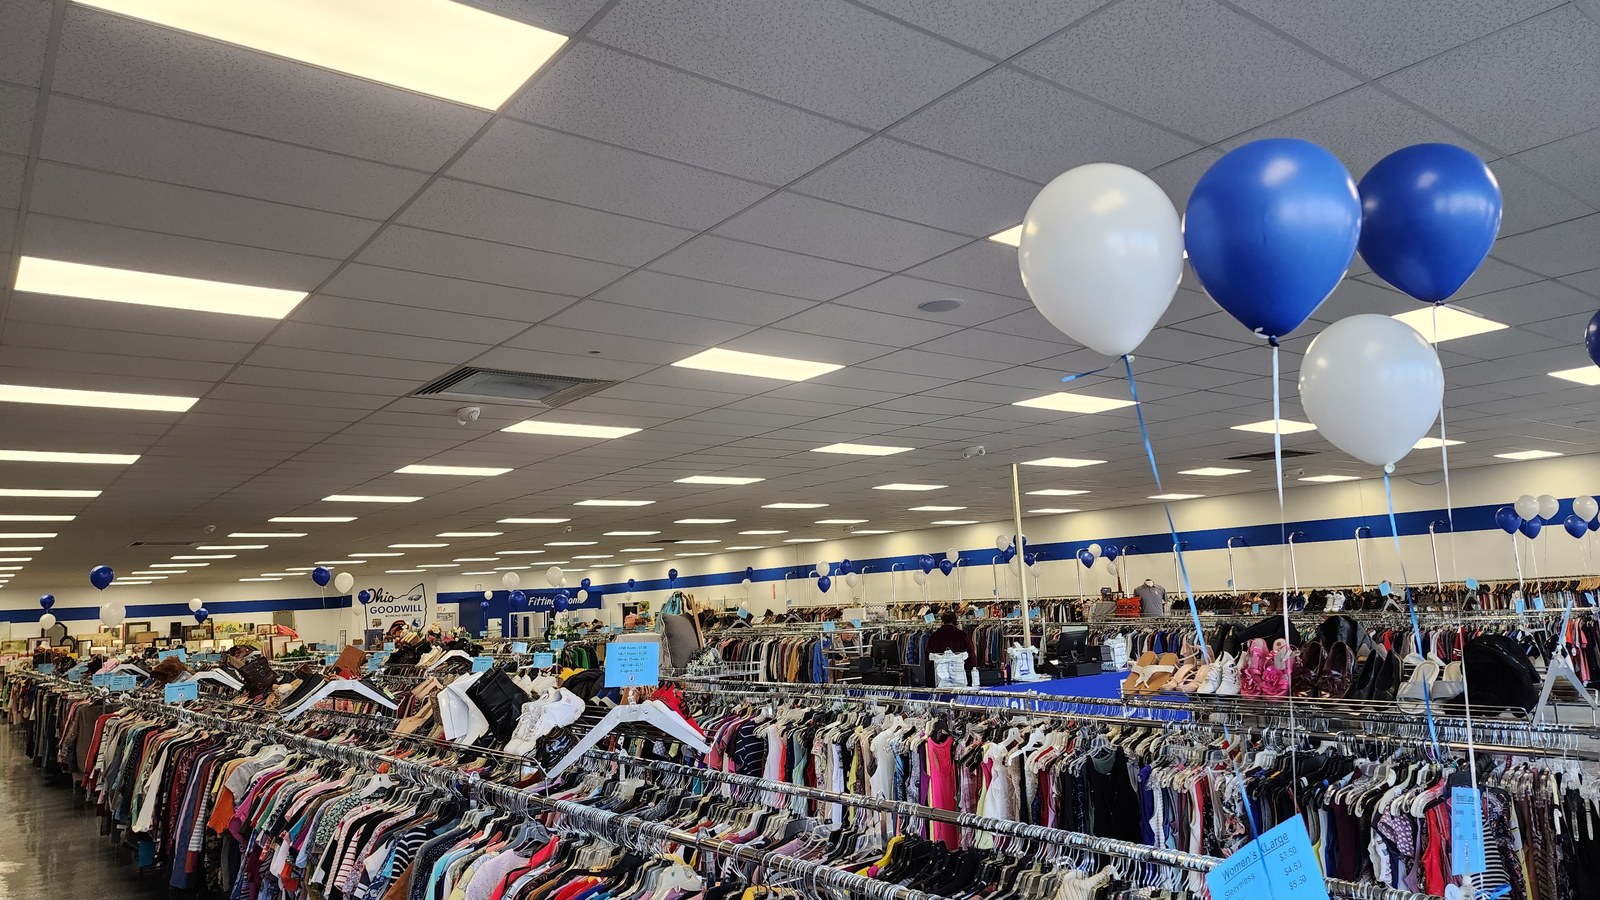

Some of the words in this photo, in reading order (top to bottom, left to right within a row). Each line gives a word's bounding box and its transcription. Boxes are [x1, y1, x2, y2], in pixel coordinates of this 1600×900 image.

[367, 588, 394, 604] Ohio
[370, 604, 422, 614] GOODWILL
[1221, 851, 1257, 881] Women's
[1224, 873, 1256, 899] Sleeveless
[1280, 846, 1297, 862] $3.50
[1284, 861, 1302, 876] $4.50
[1289, 875, 1307, 891] $5.50
